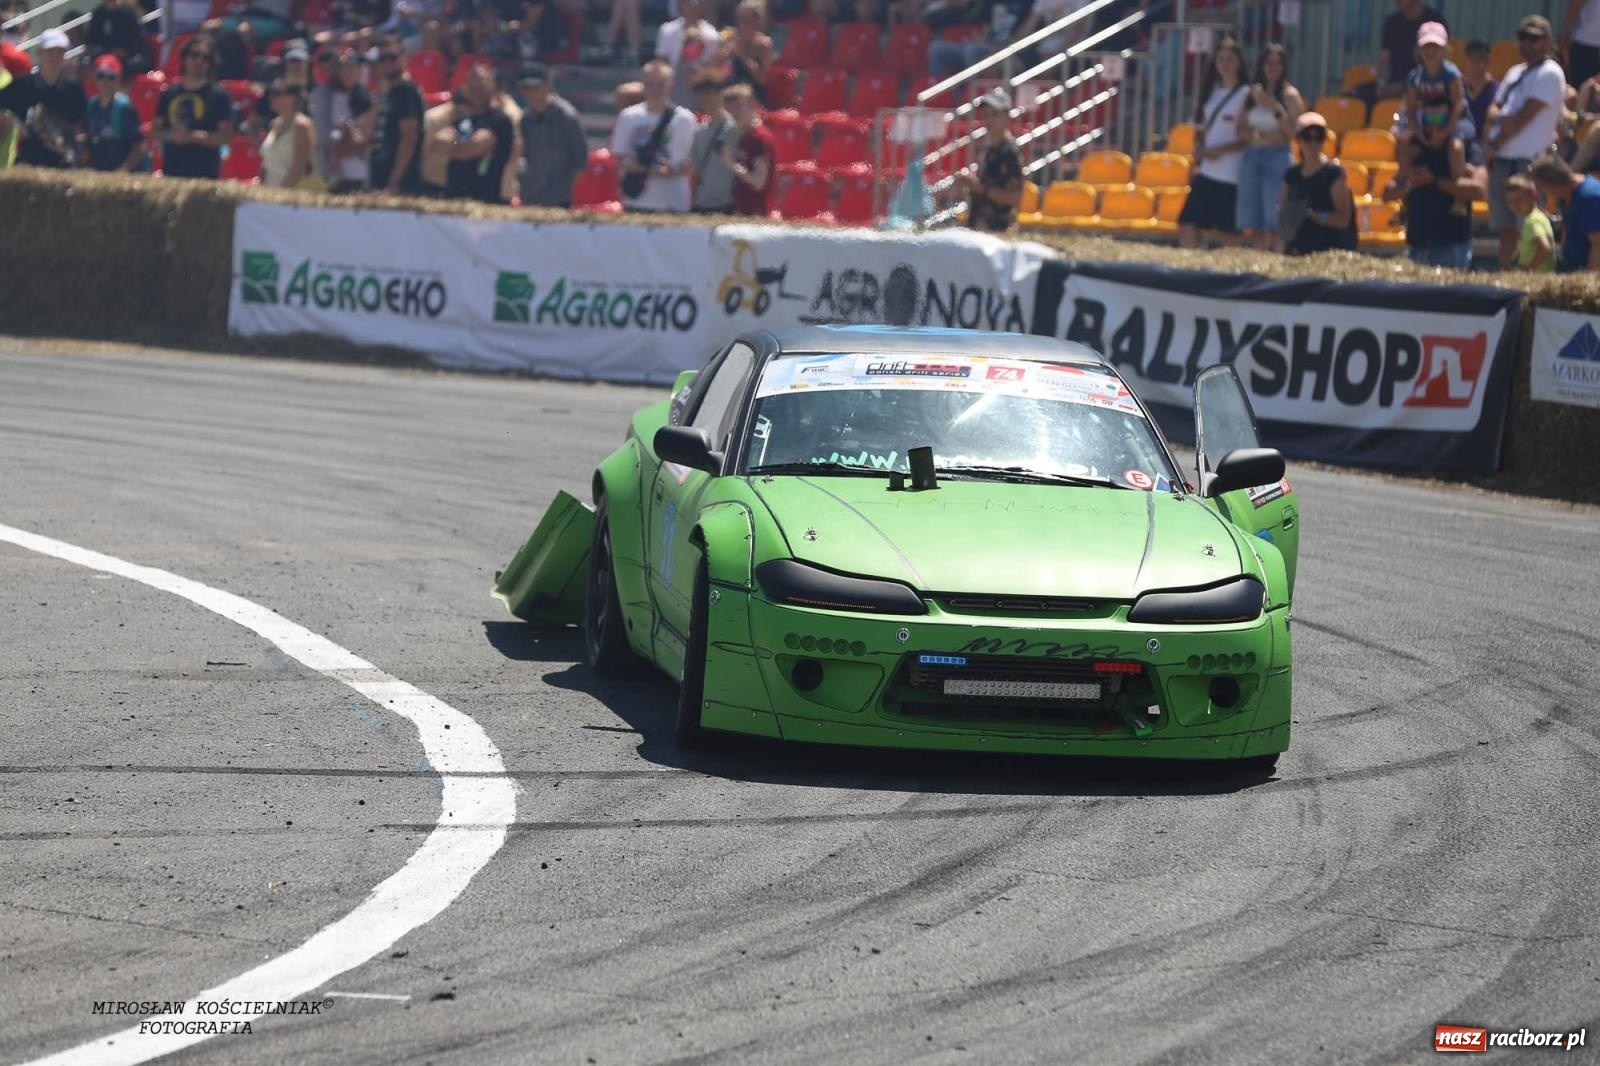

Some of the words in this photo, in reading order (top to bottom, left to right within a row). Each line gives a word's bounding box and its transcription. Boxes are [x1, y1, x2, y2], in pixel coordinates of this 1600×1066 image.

[284, 257, 447, 318] AGROEKO
[536, 277, 698, 333] AGROEKO
[991, 368, 1014, 379] 74
[1067, 298, 1422, 408] RALLYSHOP
[1132, 472, 1147, 485] E
